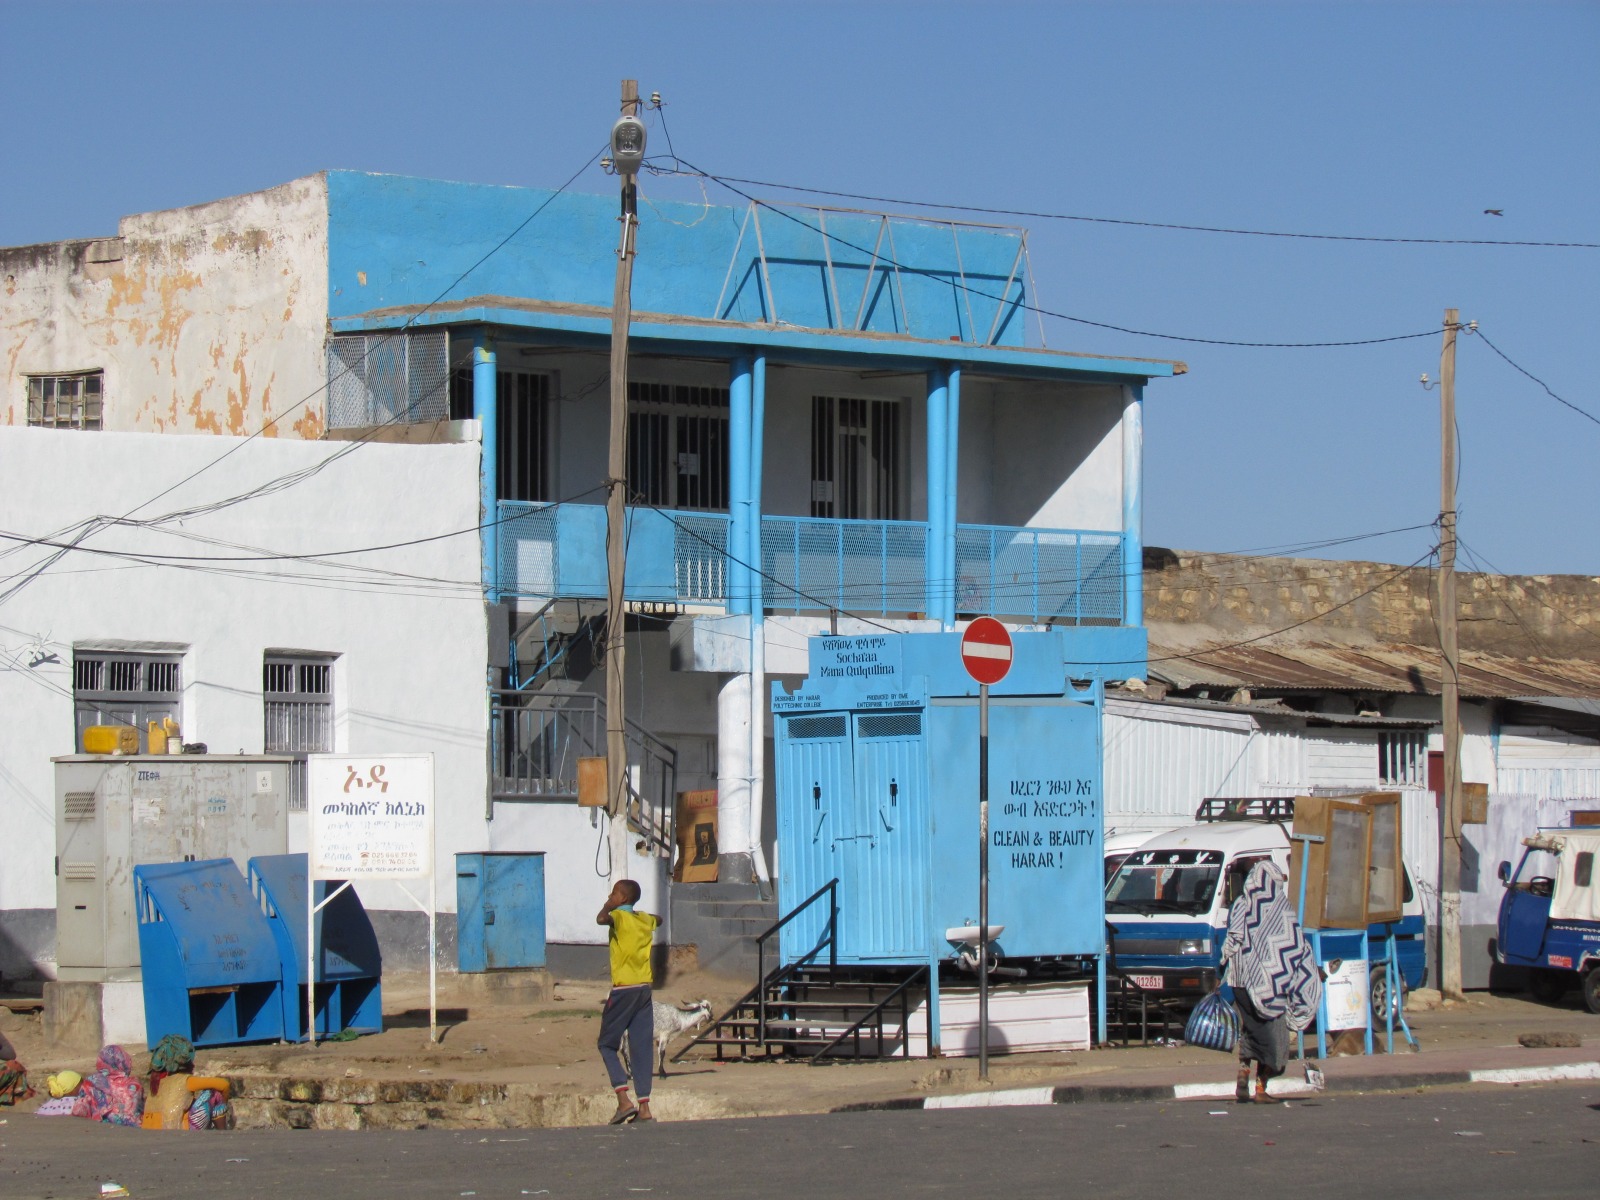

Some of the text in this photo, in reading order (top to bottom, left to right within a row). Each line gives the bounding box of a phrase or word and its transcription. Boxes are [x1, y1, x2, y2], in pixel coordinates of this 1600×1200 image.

[820, 662, 894, 679] Mana Qulqullina
[1010, 780, 1041, 796] ሀረርን
[1076, 779, 1092, 796] እና
[322, 801, 425, 816] መካከለኛ ክሊኒክ
[1004, 802, 1026, 817] ውብ
[993, 830, 1094, 846] CLEAN & BEAUTY
[1012, 852, 1054, 868] HARAR
